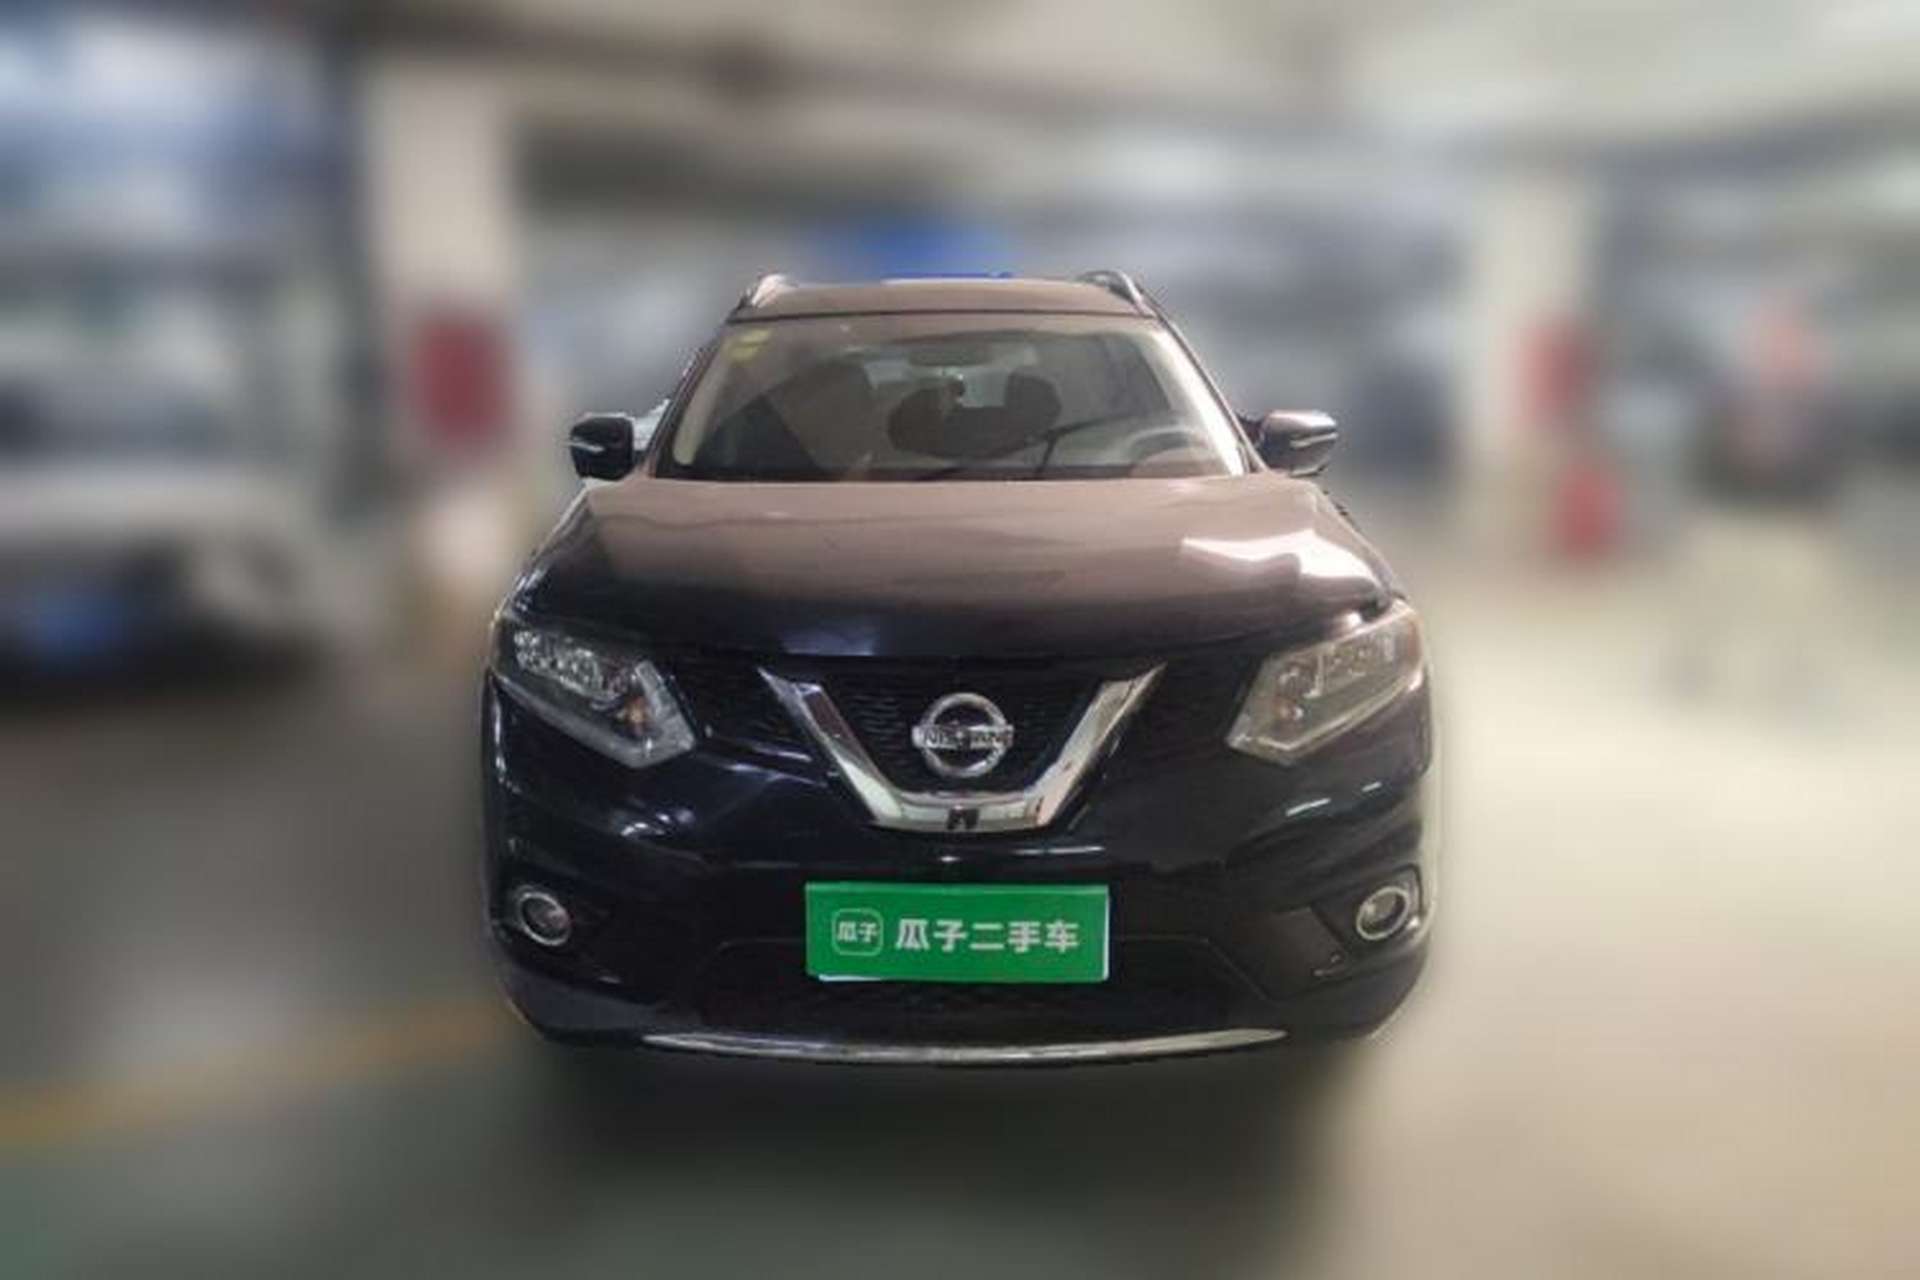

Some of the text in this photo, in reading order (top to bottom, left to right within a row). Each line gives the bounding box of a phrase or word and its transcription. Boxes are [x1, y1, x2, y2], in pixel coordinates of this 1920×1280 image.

[837, 918, 1079, 953] 瓜子 瓜子二手车
